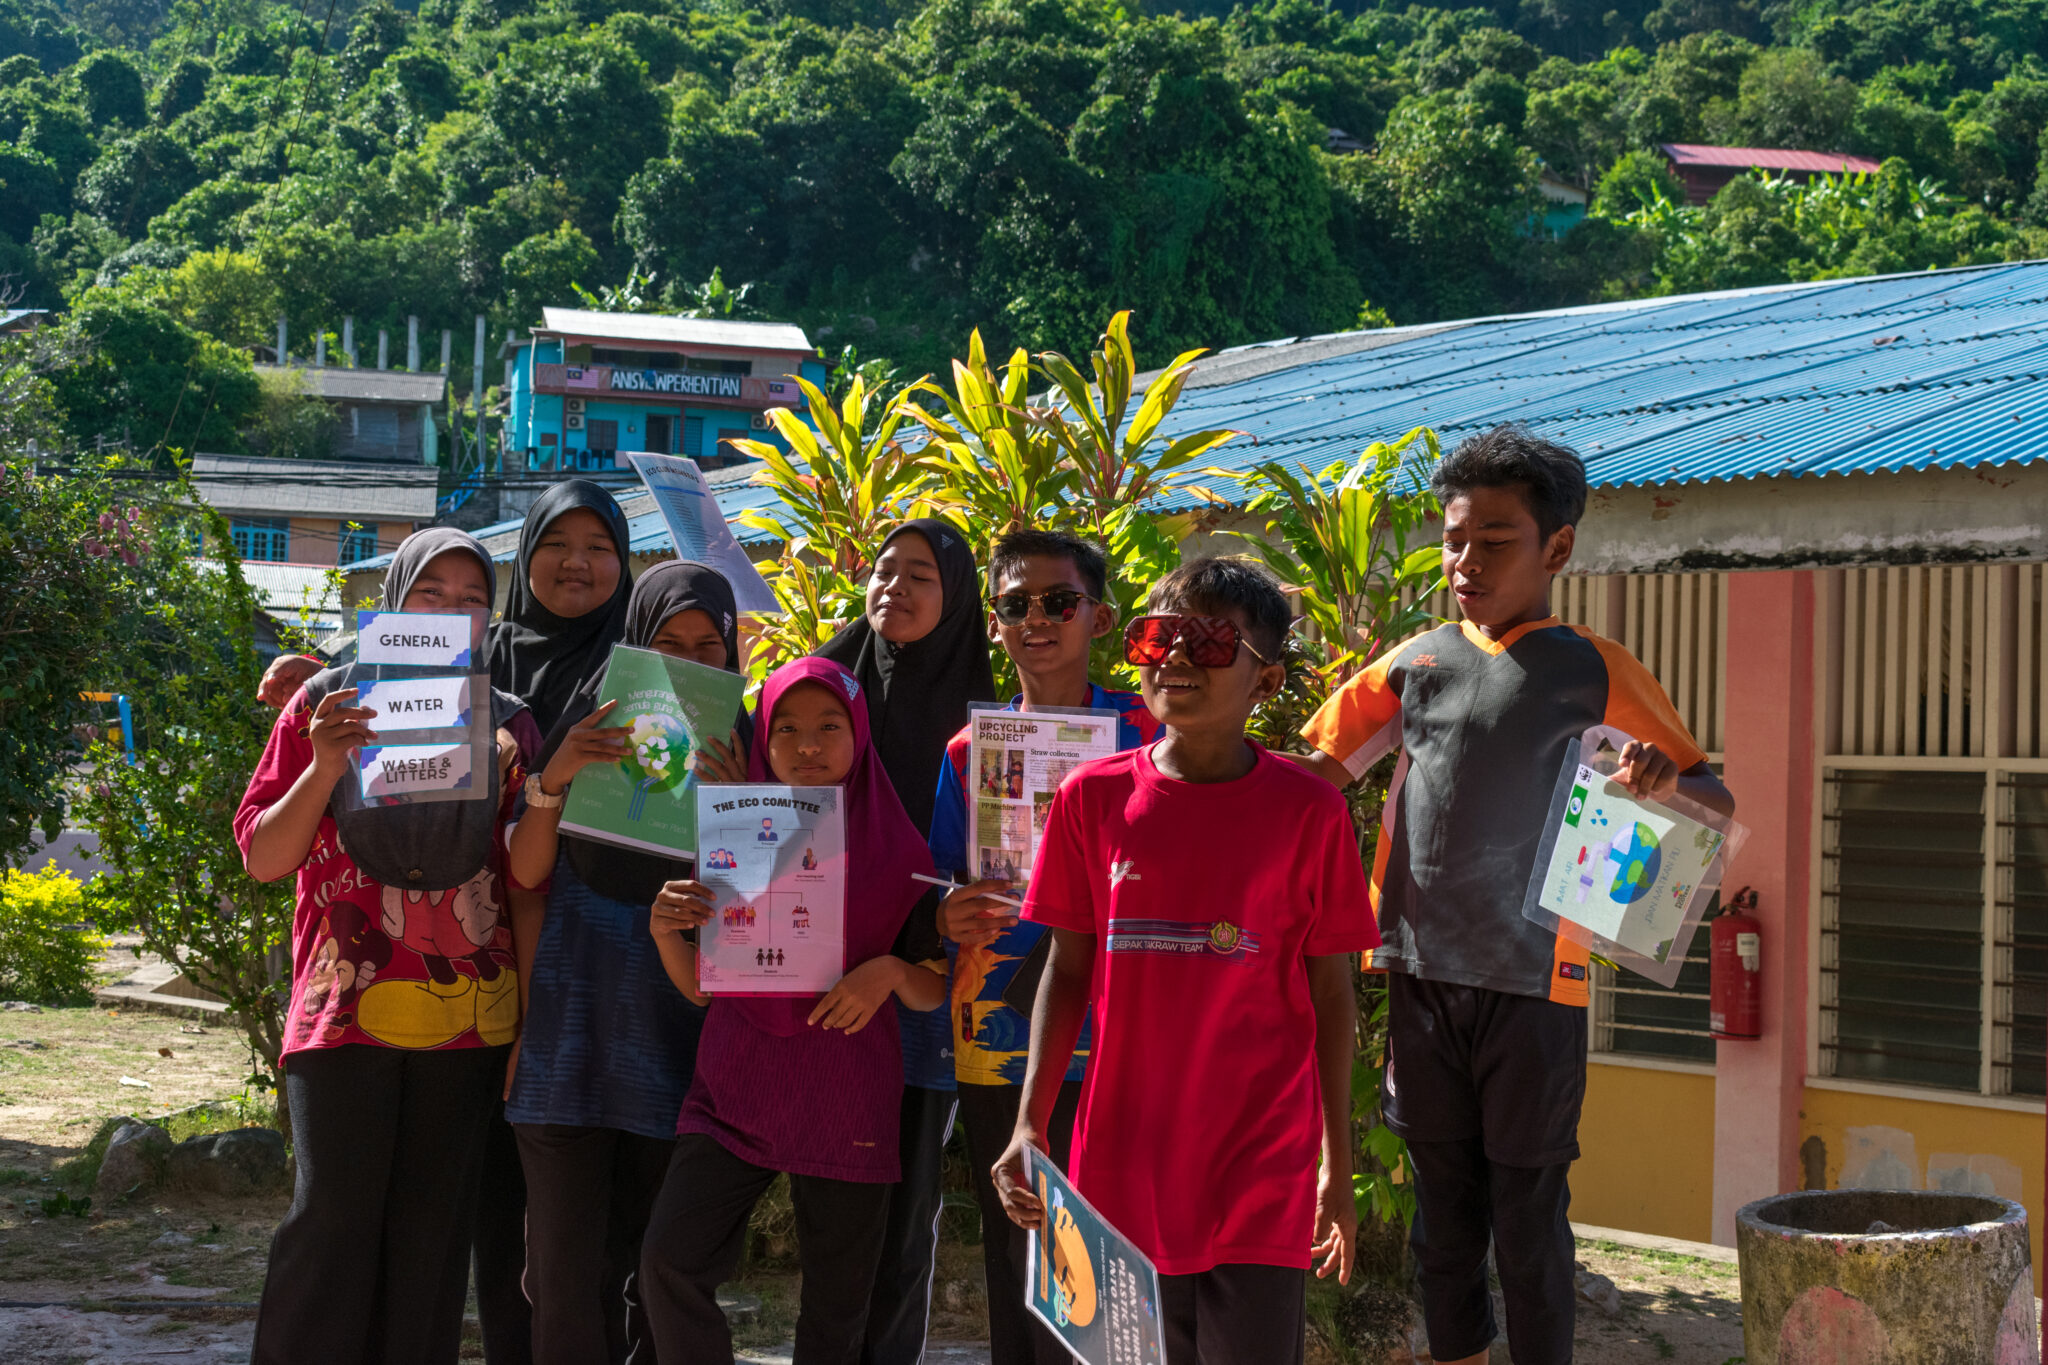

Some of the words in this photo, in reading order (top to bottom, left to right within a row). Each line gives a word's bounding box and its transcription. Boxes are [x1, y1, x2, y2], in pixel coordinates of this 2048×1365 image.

[379, 633, 450, 648] GENERAL
[388, 698, 443, 713] WATER
[653, 702, 673, 714] guna
[979, 722, 1038, 734] UPCYCLING
[979, 732, 1025, 743] PROJECT
[1030, 748, 1048, 757] Straw
[1049, 750, 1080, 758] collection
[382, 757, 436, 772] WASTE
[441, 757, 452, 768] &
[385, 768, 449, 784] LITTERS
[712, 801, 736, 814] THE
[738, 798, 759, 808] ECO
[762, 797, 821, 815] COMITTEE
[990, 803, 1017, 812] Machine
[1113, 940, 1143, 949] SEPAK
[1180, 943, 1203, 953] TEAM
[1108, 1258, 1118, 1299] INTO
[1118, 1256, 1129, 1325] PLASTIC
[1128, 1271, 1139, 1324] DON'T
[1111, 1302, 1120, 1332] THE
[1113, 1333, 1123, 1363] SEA
[1122, 1327, 1133, 1365] WAS
